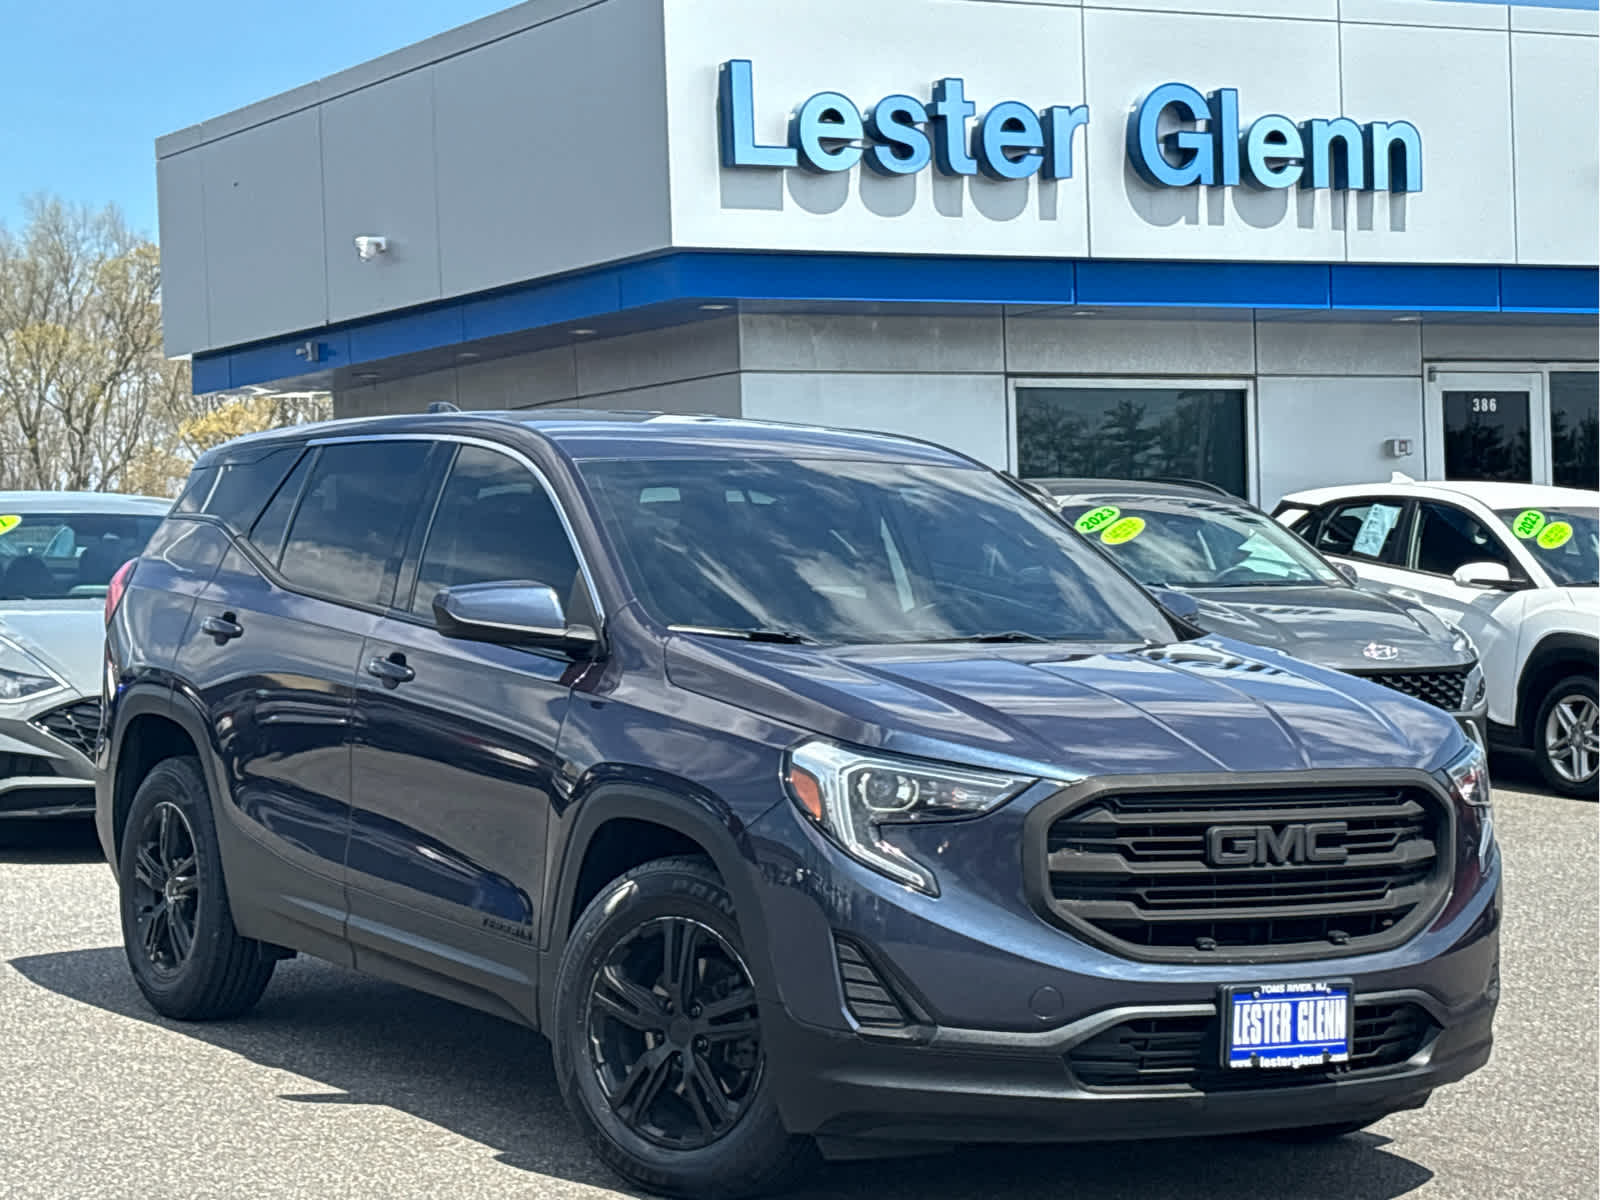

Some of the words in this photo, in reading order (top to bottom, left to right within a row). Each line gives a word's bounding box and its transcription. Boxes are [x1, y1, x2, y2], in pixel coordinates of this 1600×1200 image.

[719, 58, 1089, 181] Lester
[1128, 82, 1422, 194] Glenn
[1472, 398, 1497, 412] 386
[1080, 507, 1116, 531] 2023
[1517, 511, 1541, 536] 2023
[1207, 821, 1348, 868] GMC
[1233, 1002, 1292, 1046] LESTER
[1297, 999, 1347, 1042] GLENN
[1260, 1054, 1324, 1069] lesterglenn
